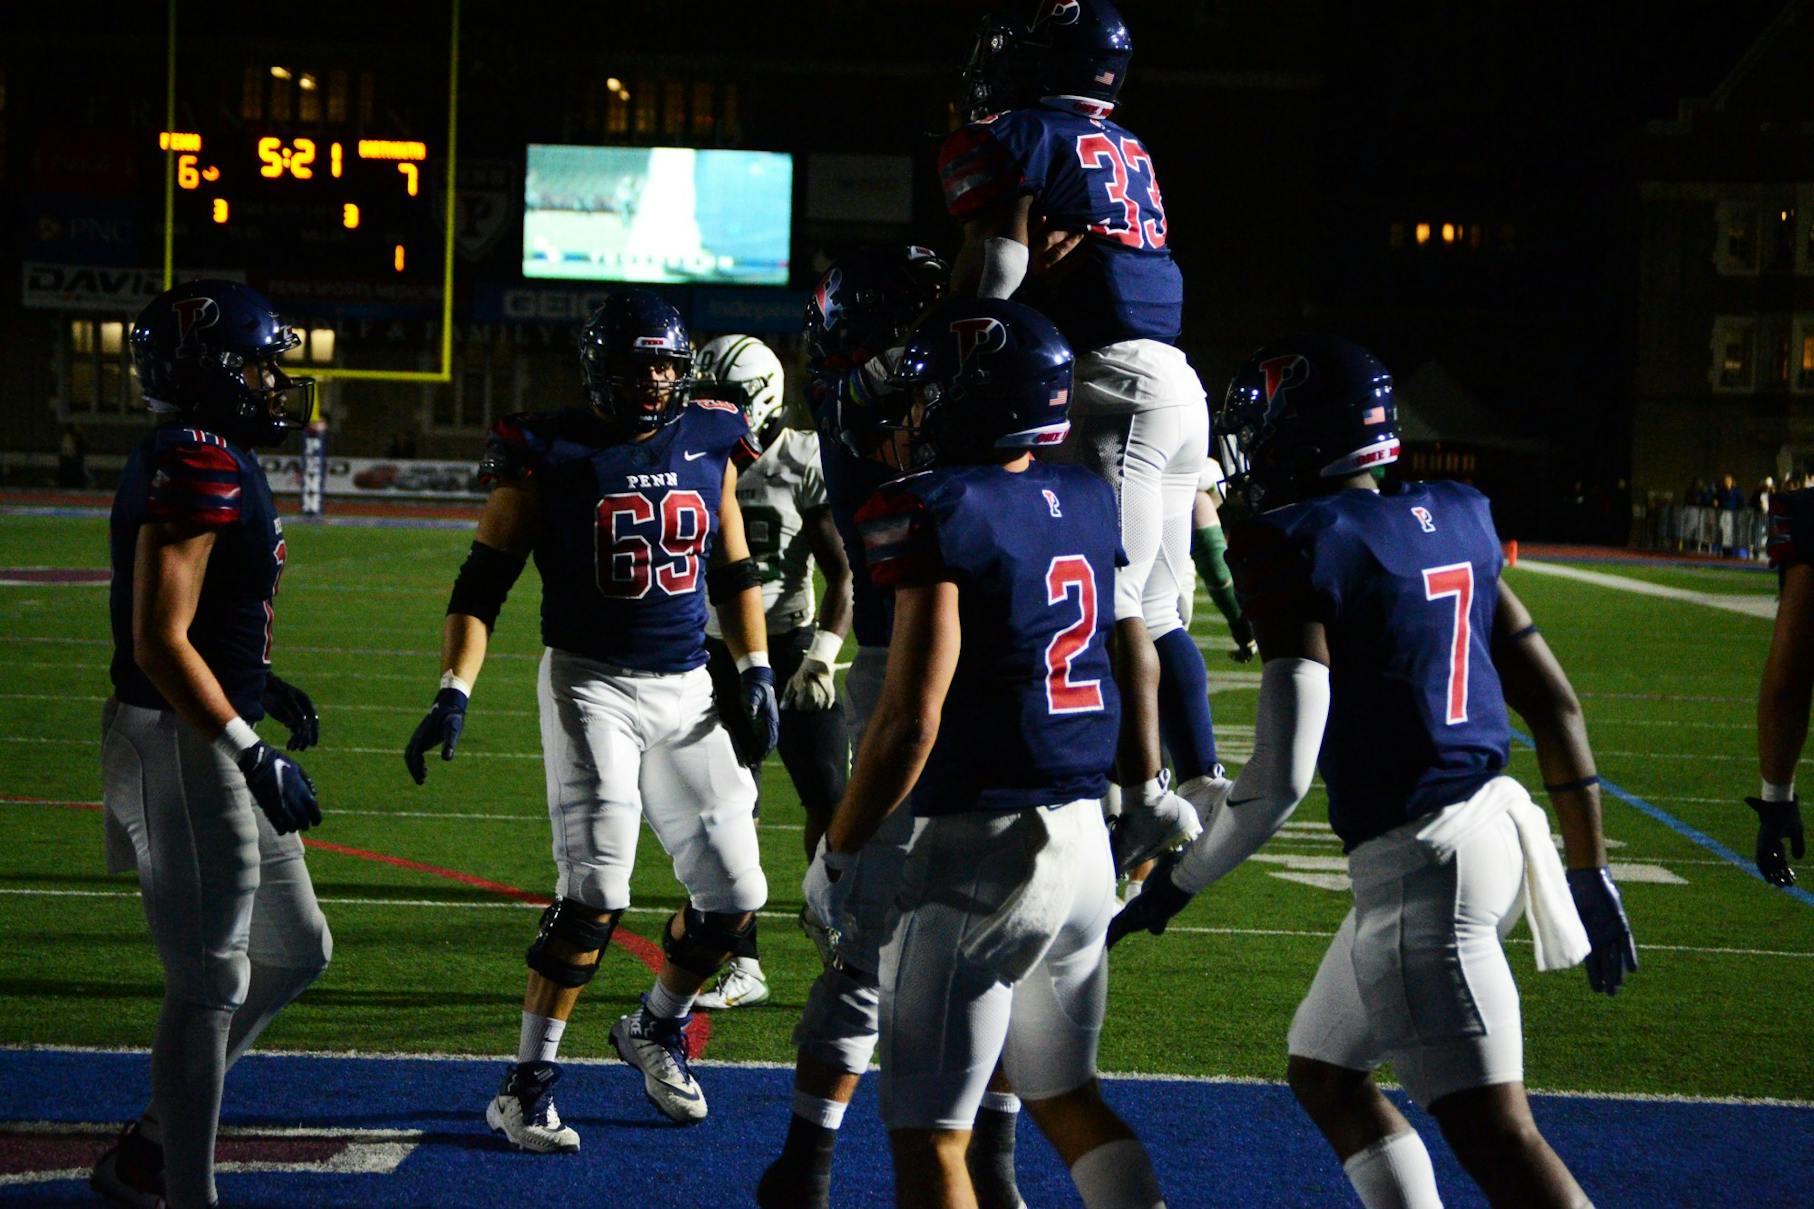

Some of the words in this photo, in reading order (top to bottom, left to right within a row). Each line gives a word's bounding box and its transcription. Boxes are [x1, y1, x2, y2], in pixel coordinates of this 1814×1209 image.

[397, 162, 418, 197] 7
[1076, 133, 1168, 249] 33
[172, 297, 220, 360] P
[950, 317, 1007, 386] P
[1259, 354, 1311, 421] P
[625, 471, 678, 489] PENN
[594, 489, 710, 600] 69
[1044, 553, 1106, 715] 2
[1420, 560, 1475, 727] 7
